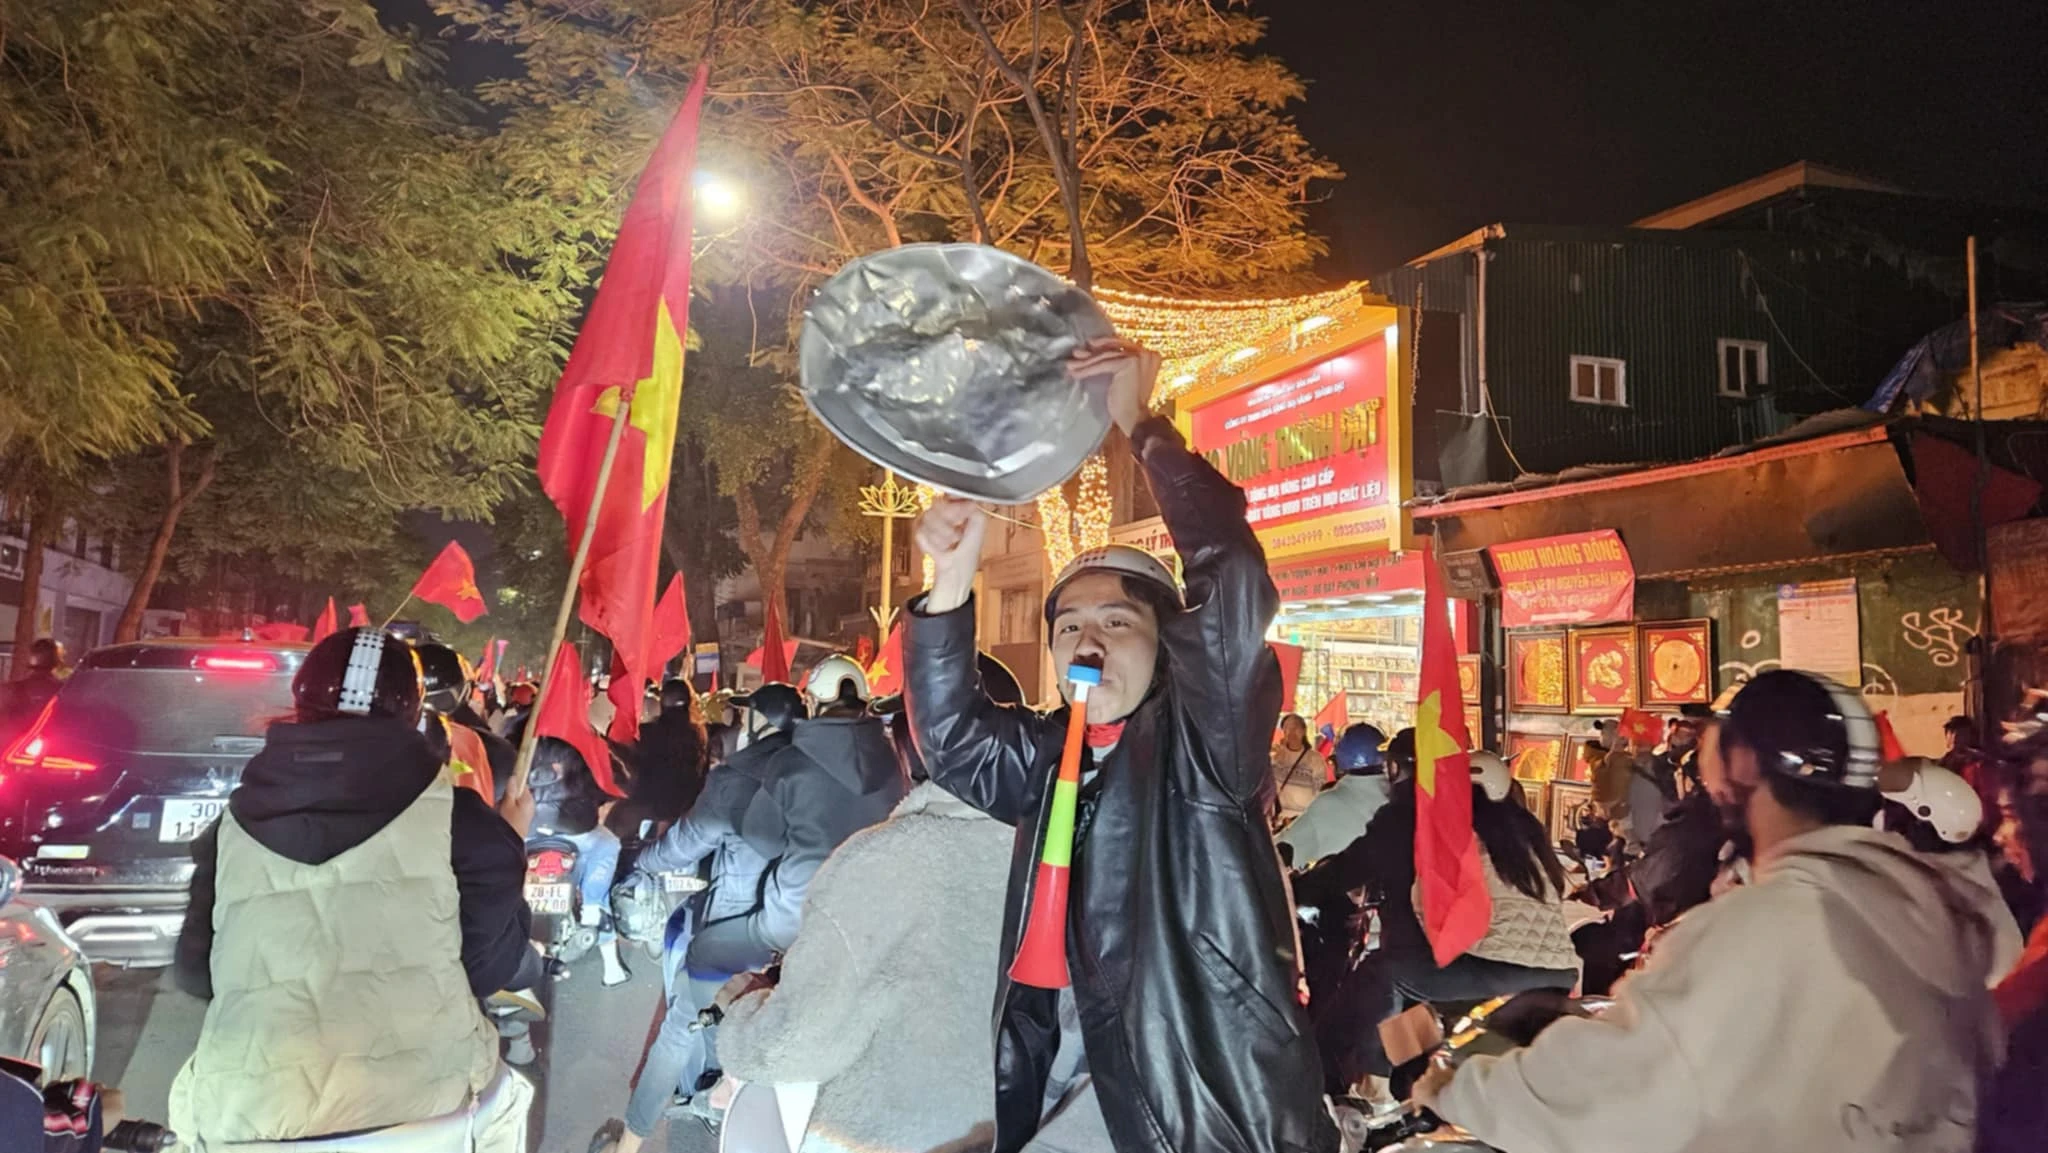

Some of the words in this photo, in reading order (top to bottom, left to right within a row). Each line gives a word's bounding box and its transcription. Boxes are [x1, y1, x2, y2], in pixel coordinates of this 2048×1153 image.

[1226, 430, 1271, 481] VÀNG
[1275, 411, 1336, 470] THÀNH
[1340, 396, 1382, 459] ĐẠT
[1497, 548, 1538, 573] TRANH
[1537, 540, 1583, 568] HOÀNG
[191, 801, 224, 819] 30
